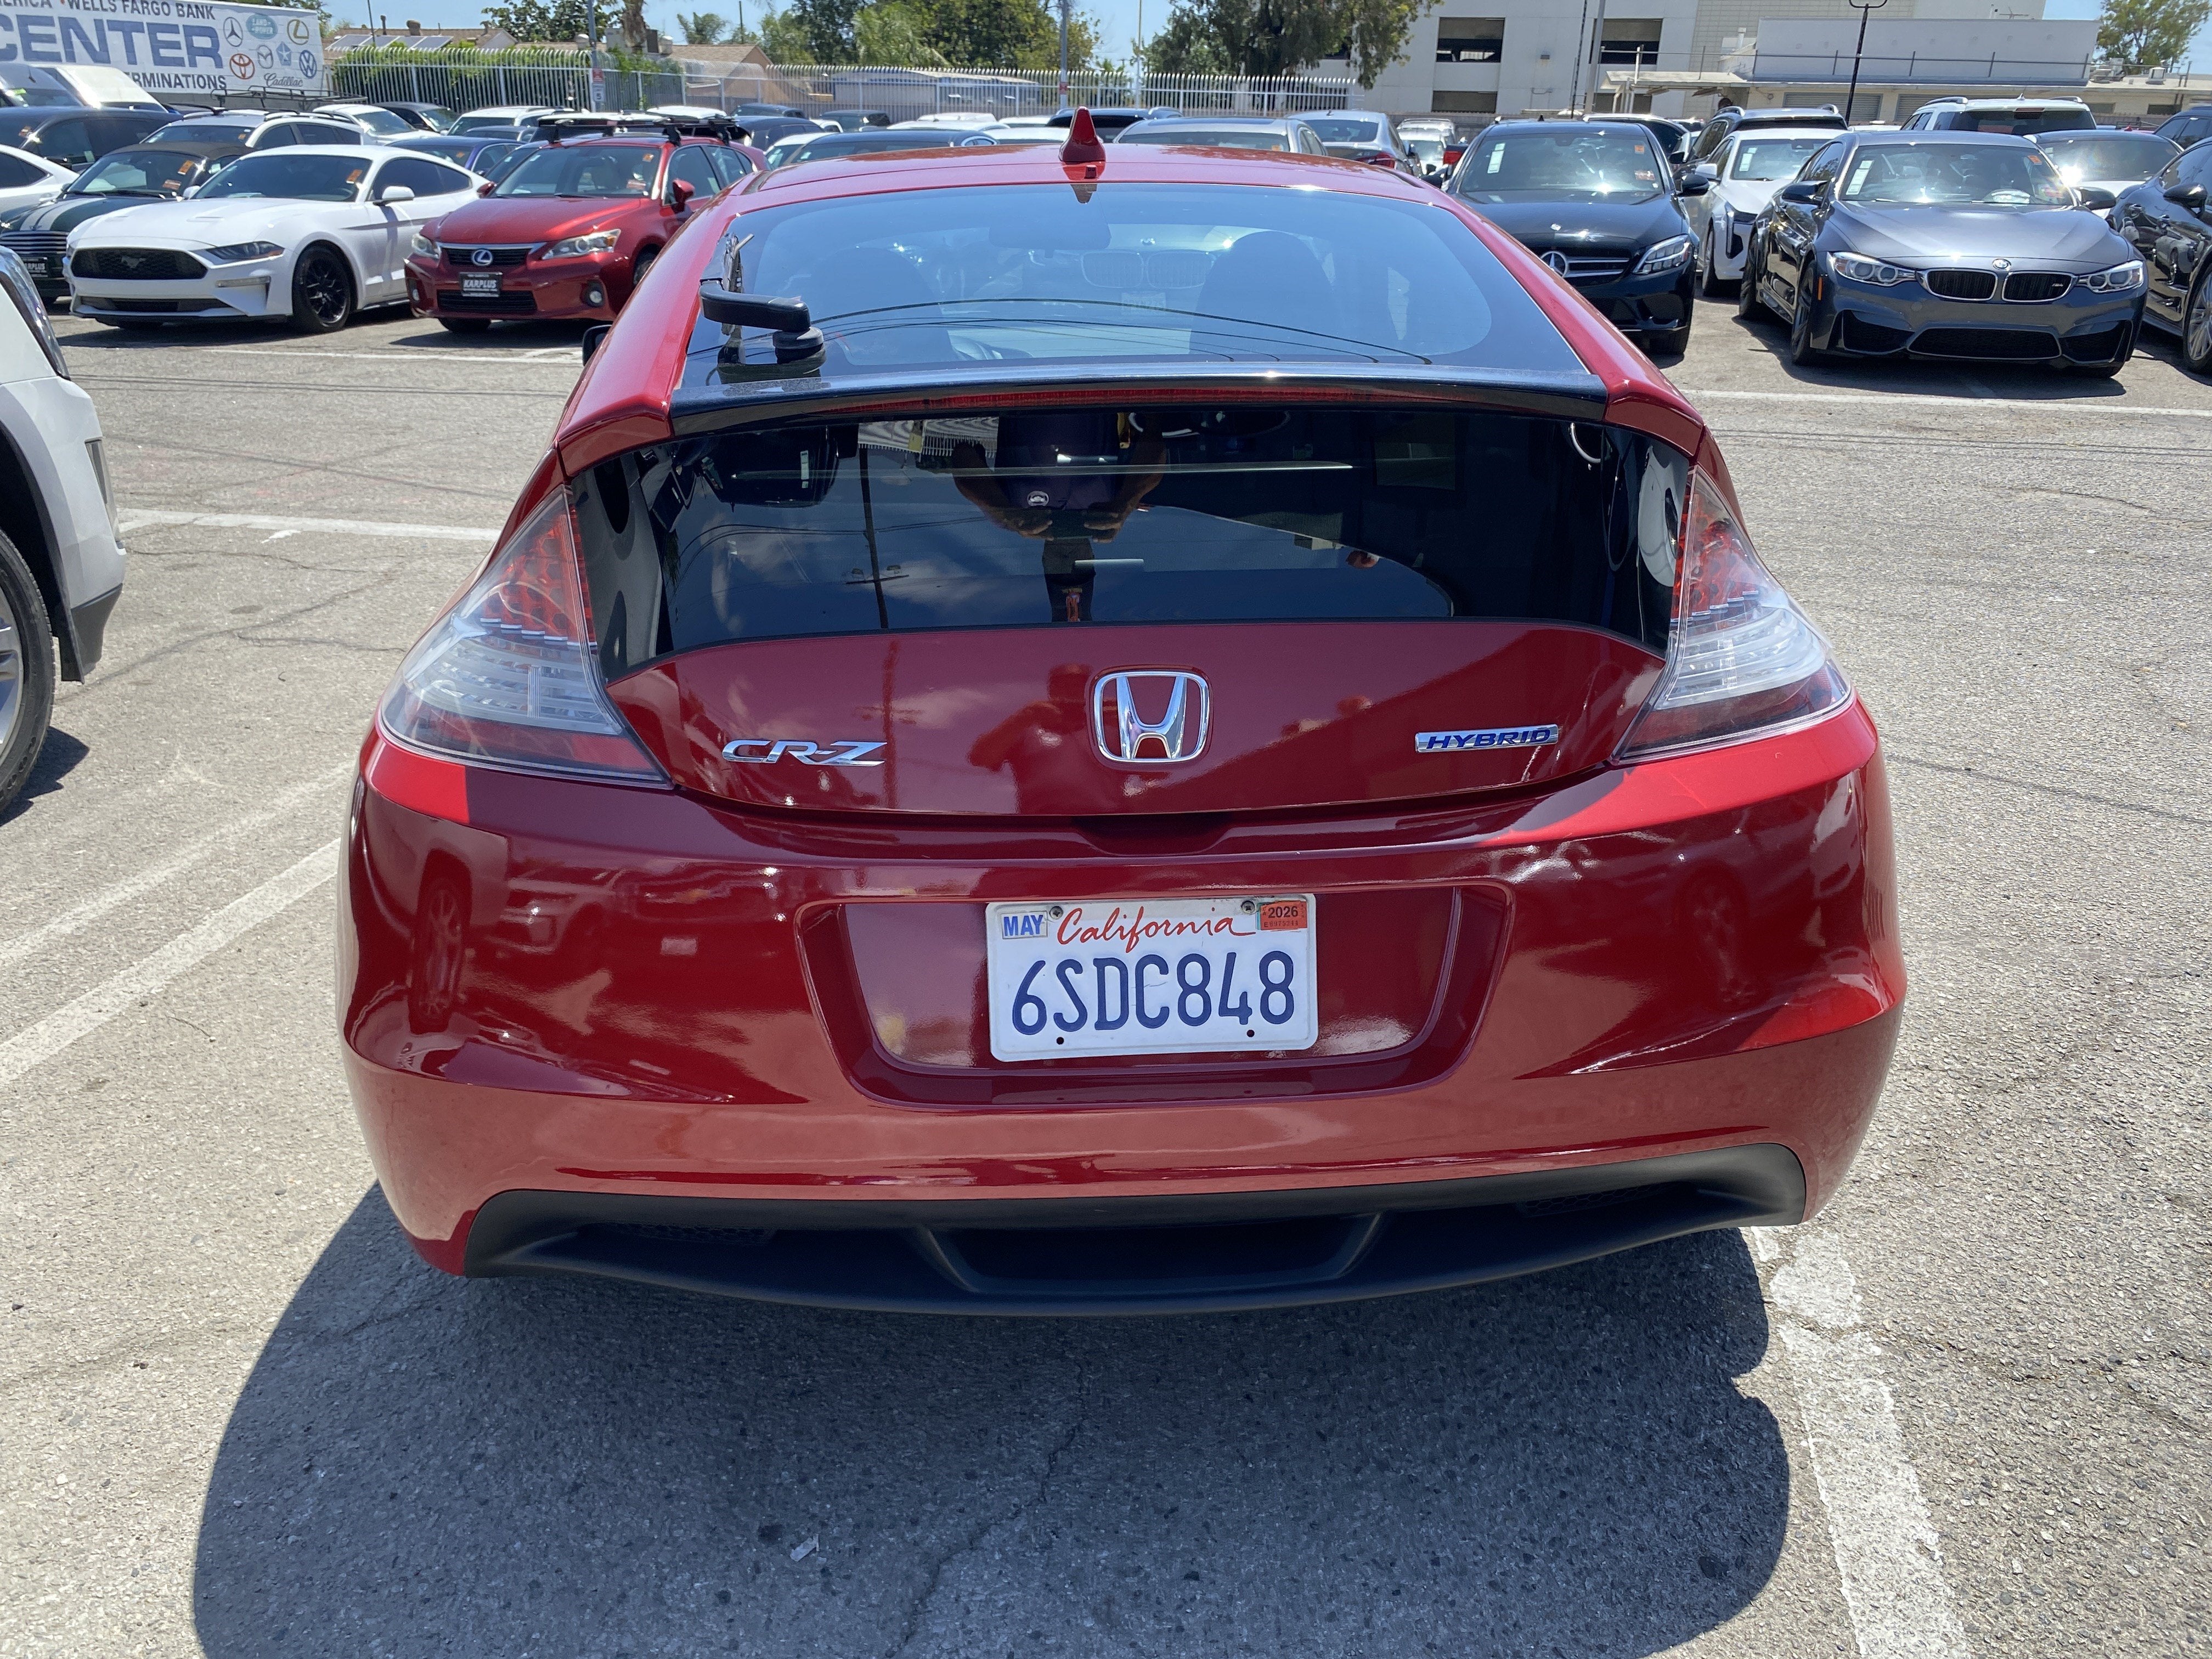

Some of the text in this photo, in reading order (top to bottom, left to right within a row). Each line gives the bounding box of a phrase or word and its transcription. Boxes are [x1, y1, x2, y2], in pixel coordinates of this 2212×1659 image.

[67, 0, 117, 13] WELLS
[122, 0, 171, 16] FARGO
[176, 3, 216, 20] BANK
[125, 72, 227, 89] RMINATIONS
[263, 73, 303, 87] Cadillac
[464, 279, 496, 288] KARPLUS
[1426, 729, 1550, 749] HYBRID
[722, 740, 887, 766] CR-Z
[1268, 906, 1299, 918] 2026
[1003, 914, 1043, 937] MAY
[1057, 906, 1256, 953] California
[1012, 951, 1295, 1036] 6SDC848
